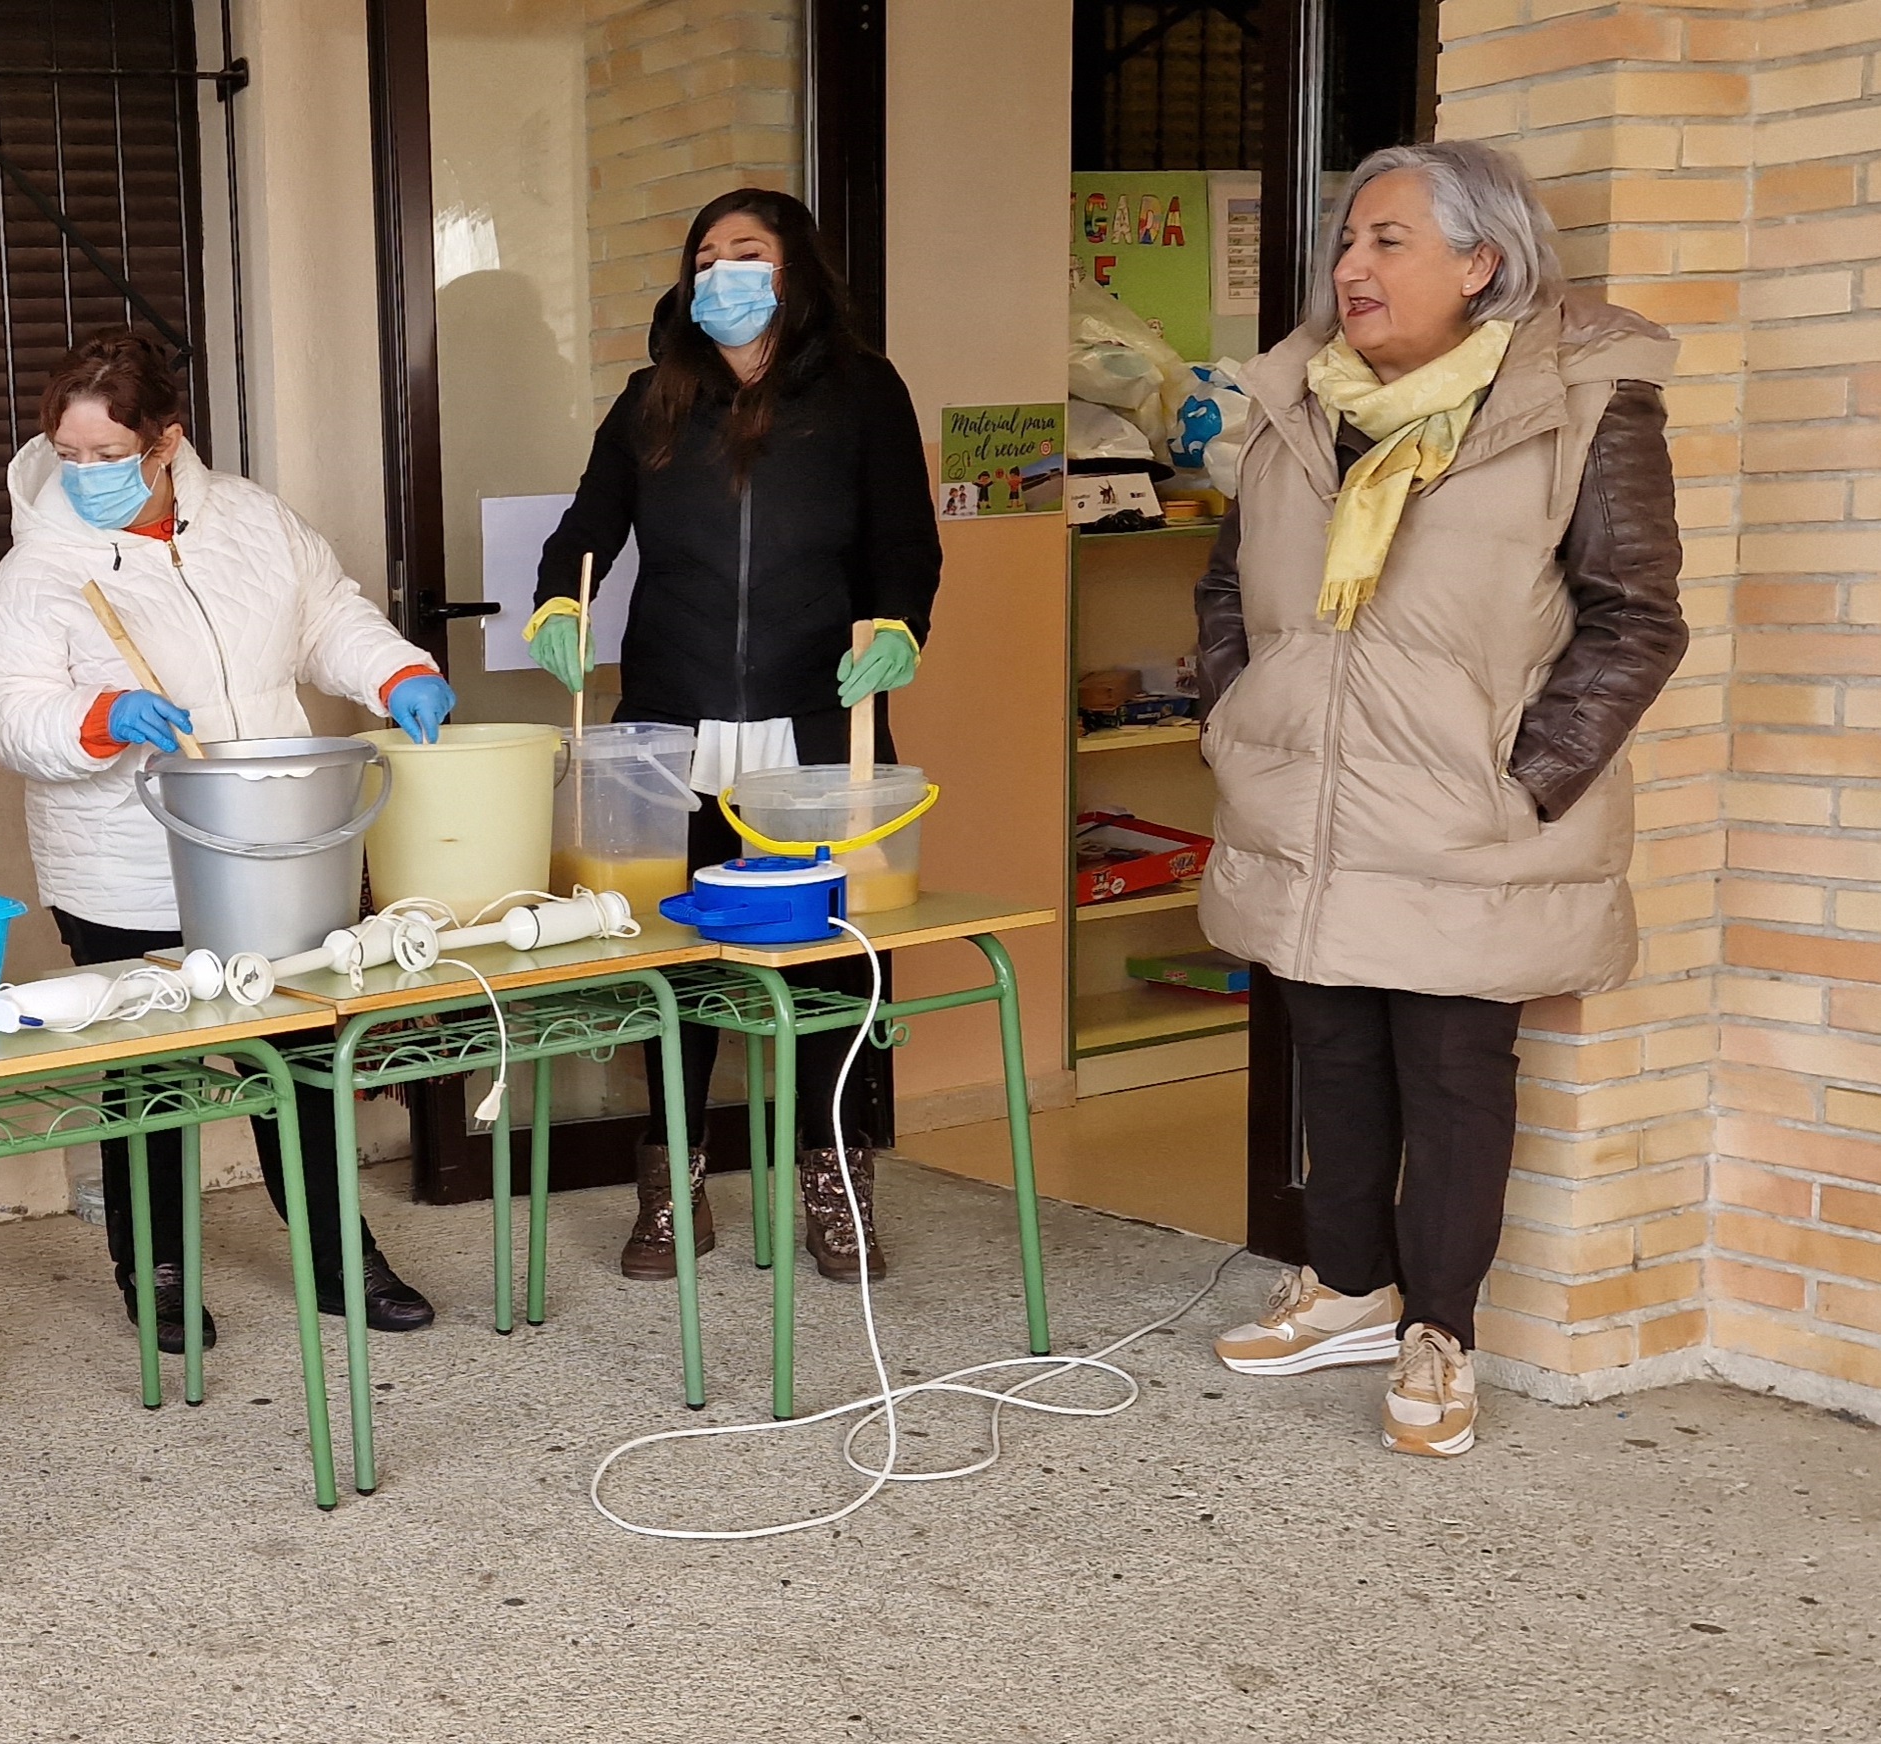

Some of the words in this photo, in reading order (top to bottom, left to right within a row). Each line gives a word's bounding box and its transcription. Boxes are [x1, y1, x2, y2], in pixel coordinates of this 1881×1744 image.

[951, 407, 1020, 438] Material
[1021, 414, 1056, 438] para
[974, 434, 991, 460] el
[994, 441, 1036, 458] recreo
